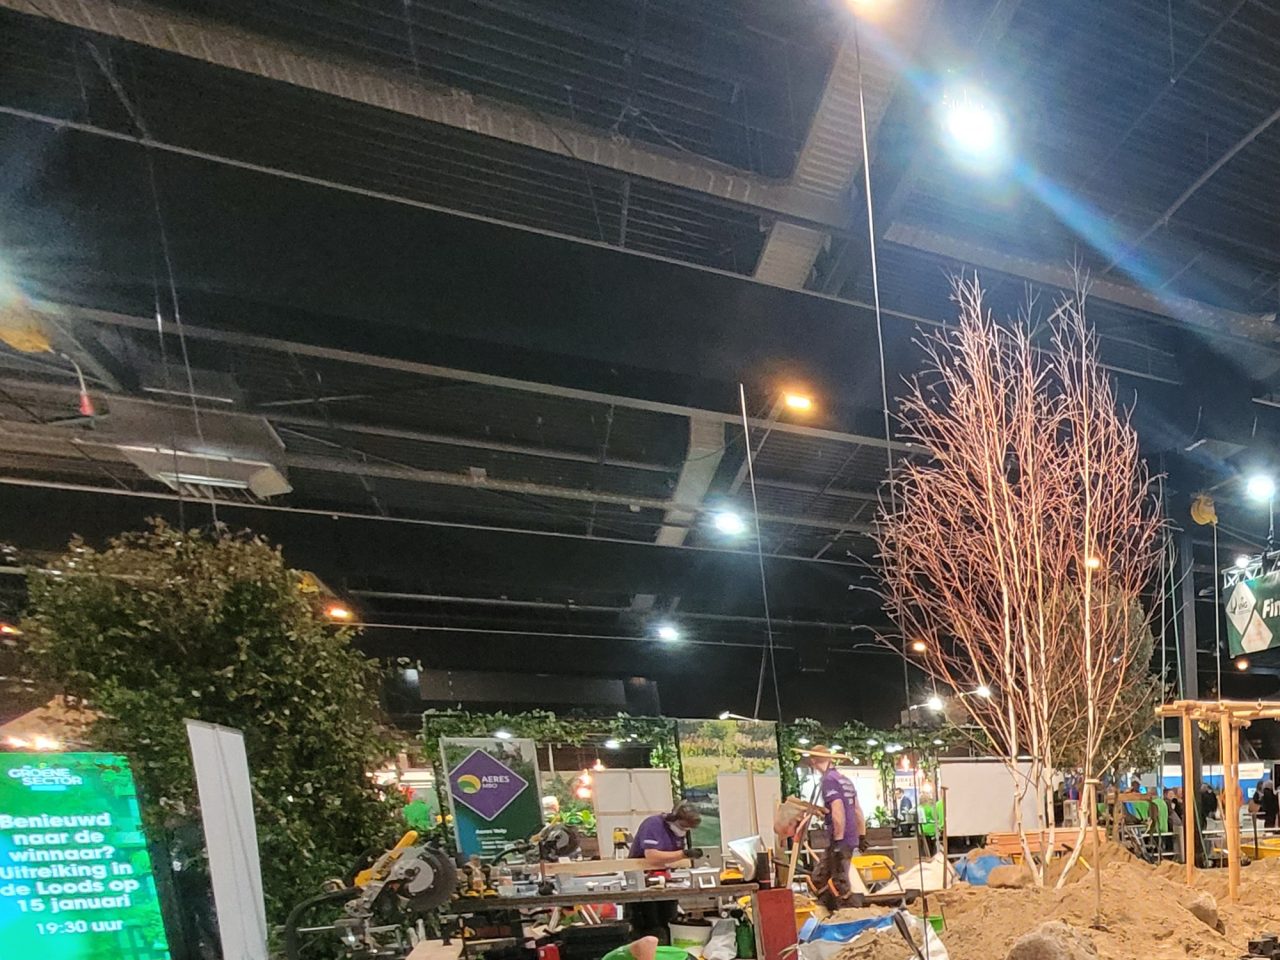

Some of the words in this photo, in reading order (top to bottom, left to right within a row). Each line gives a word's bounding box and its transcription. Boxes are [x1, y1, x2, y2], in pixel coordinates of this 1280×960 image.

[8, 767, 71, 778] GROENE
[22, 775, 83, 786] SECTOR
[481, 775, 510, 783] AERES
[0, 812, 112, 829] Benieuwd
[13, 832, 69, 846] naar
[74, 829, 105, 844] de
[9, 845, 116, 862] winnaar?
[0, 863, 107, 880] Uitreiking
[112, 861, 133, 876] in
[0, 883, 31, 896] de
[36, 879, 105, 895] Loods
[109, 878, 140, 893] op
[17, 898, 46, 912] 15
[51, 893, 131, 914] januari
[37, 919, 88, 935] 19:30
[91, 919, 125, 932] uur
